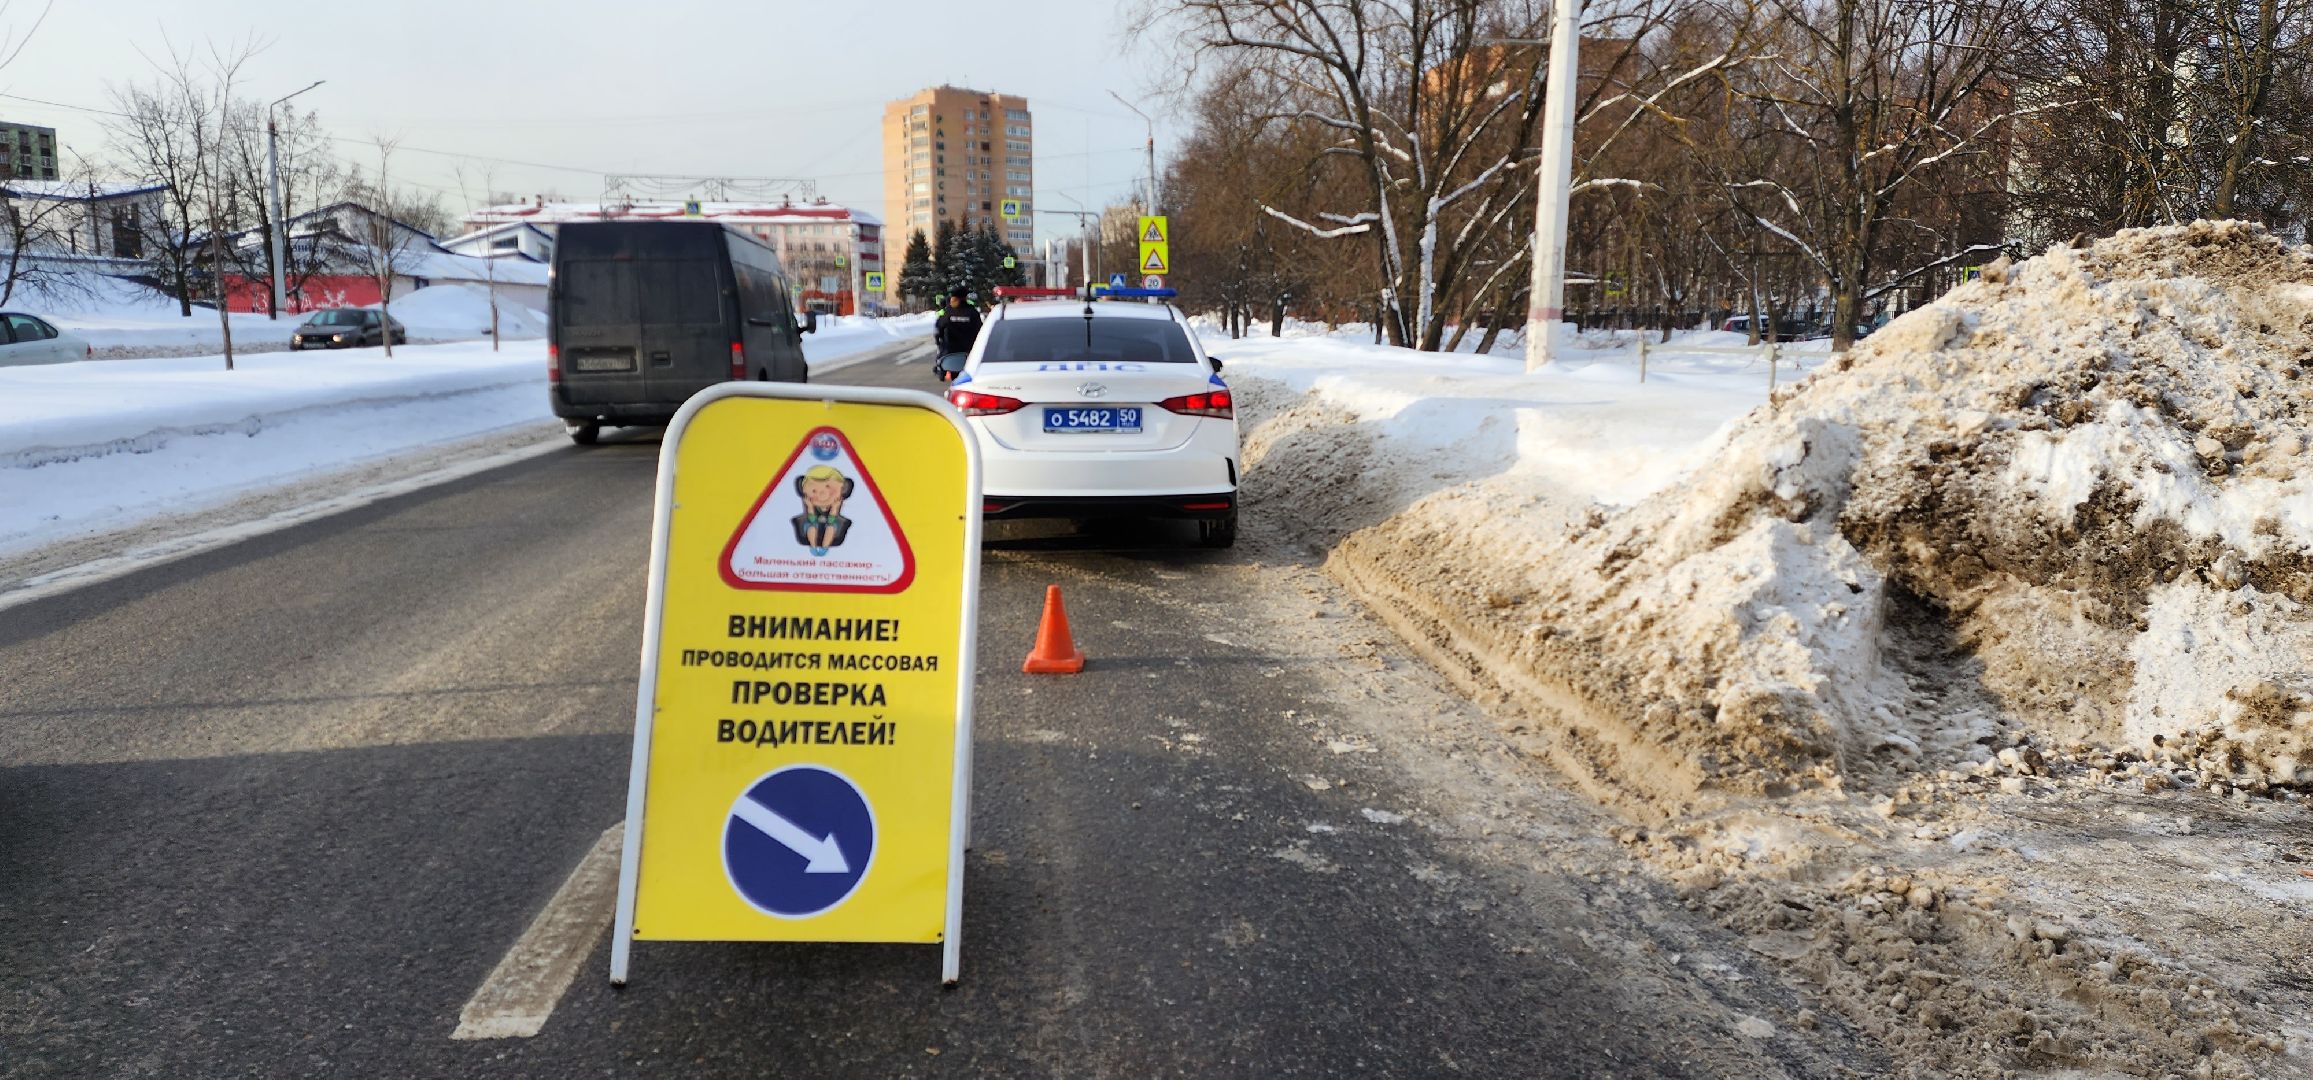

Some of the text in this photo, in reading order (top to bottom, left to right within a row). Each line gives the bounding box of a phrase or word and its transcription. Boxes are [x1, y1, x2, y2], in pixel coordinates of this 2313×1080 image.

[1147, 278, 1159, 287] 20
[1068, 410, 1111, 427] 5482
[1120, 409, 1137, 423] 50
[753, 556, 816, 568] Маленький
[819, 559, 873, 571] пассажир
[738, 567, 891, 583] большая ответственность!
[727, 614, 900, 642] ВНИМАНИЕ!
[680, 648, 939, 672] ПРОВОДИТСЯ МАССОВАЯ
[731, 679, 888, 708] ПРОВЕРКА
[716, 713, 897, 750] ВОДИТЕЛЕЙ!
